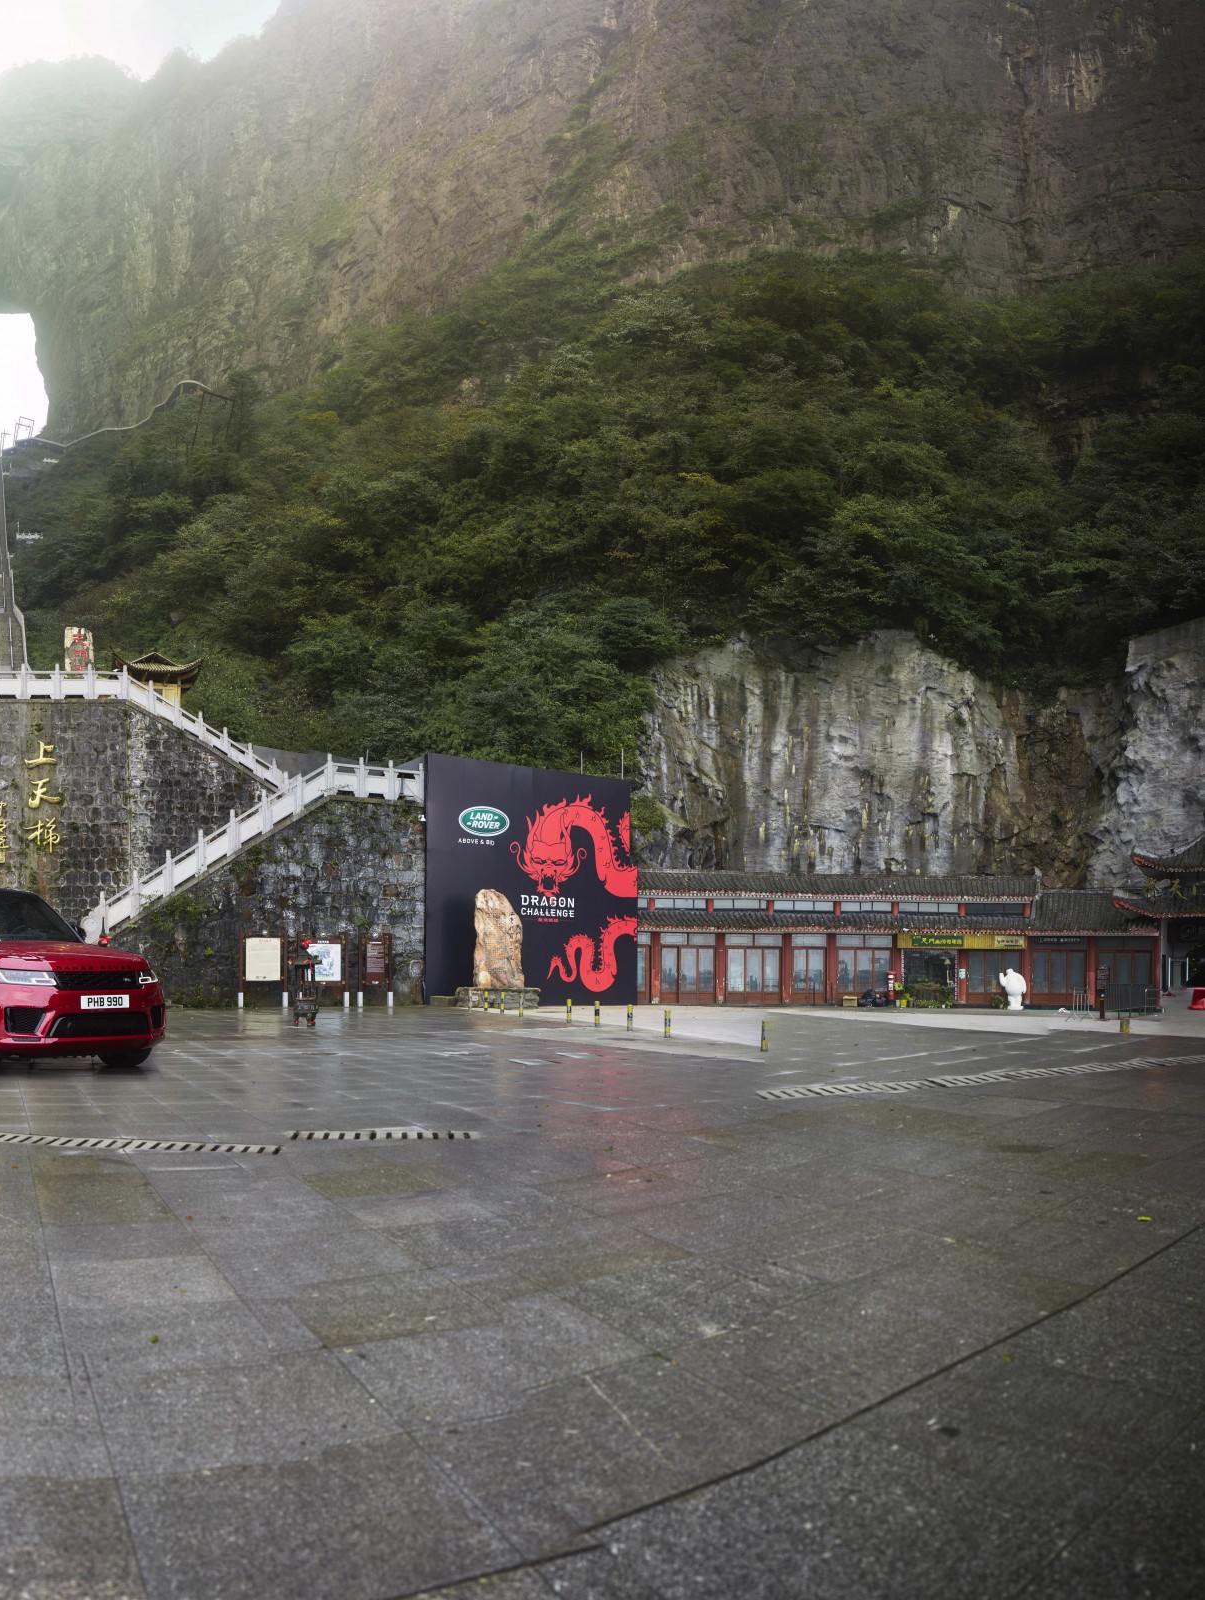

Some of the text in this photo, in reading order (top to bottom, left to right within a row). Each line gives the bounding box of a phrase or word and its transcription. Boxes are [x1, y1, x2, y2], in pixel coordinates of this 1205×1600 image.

[24, 740, 63, 854] 上天梯
[469, 811, 494, 821] LAND
[471, 820, 501, 829] ROVER
[520, 894, 575, 908] DRAGON
[520, 907, 575, 918] CHALLENGE
[87, 996, 124, 1007] PHB 990
